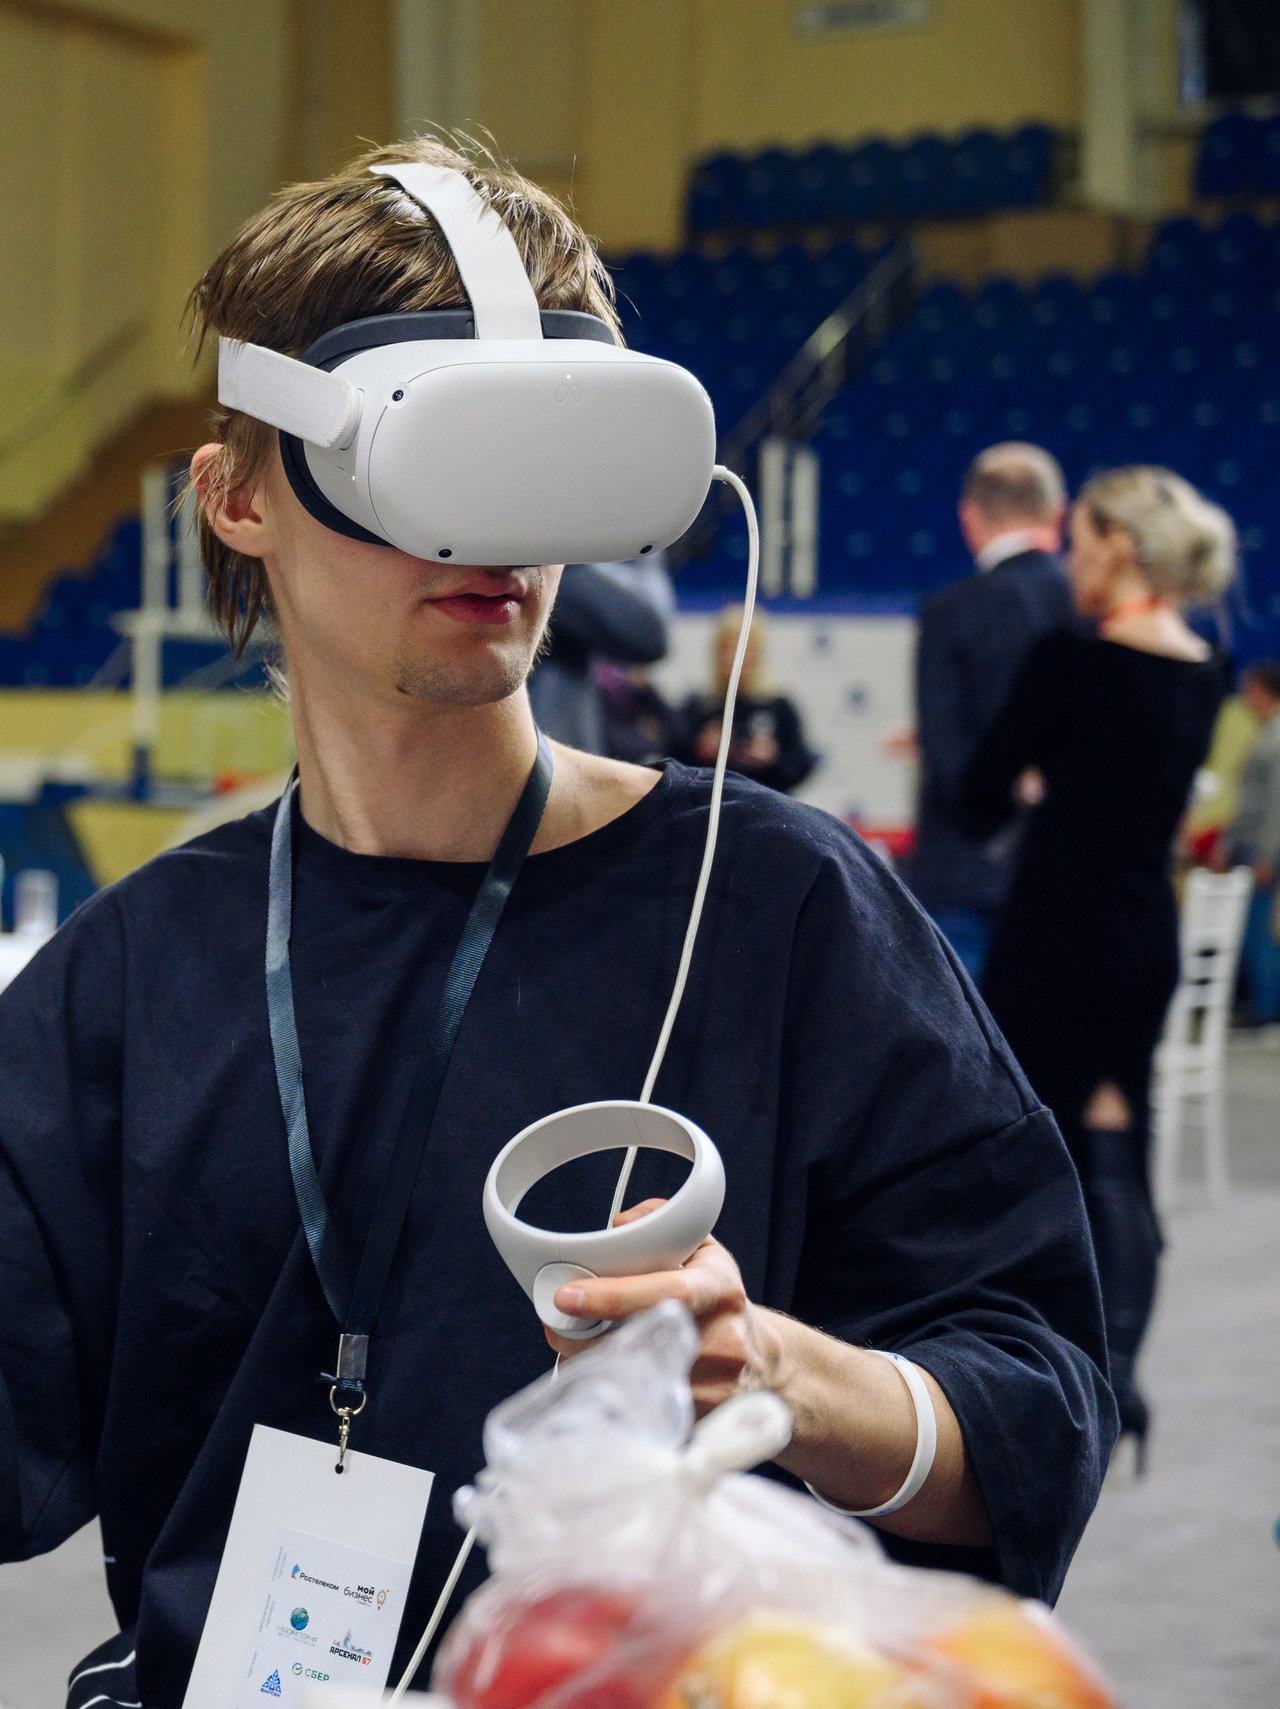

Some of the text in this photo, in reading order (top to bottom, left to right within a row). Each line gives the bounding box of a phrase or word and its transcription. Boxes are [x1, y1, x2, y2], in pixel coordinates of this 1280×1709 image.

[300, 1572, 339, 1591] Ростелеком
[343, 1586, 373, 1604] бизнес
[329, 1646, 362, 1662] АРСЕНАЛ
[305, 1668, 330, 1682] СБЕР
